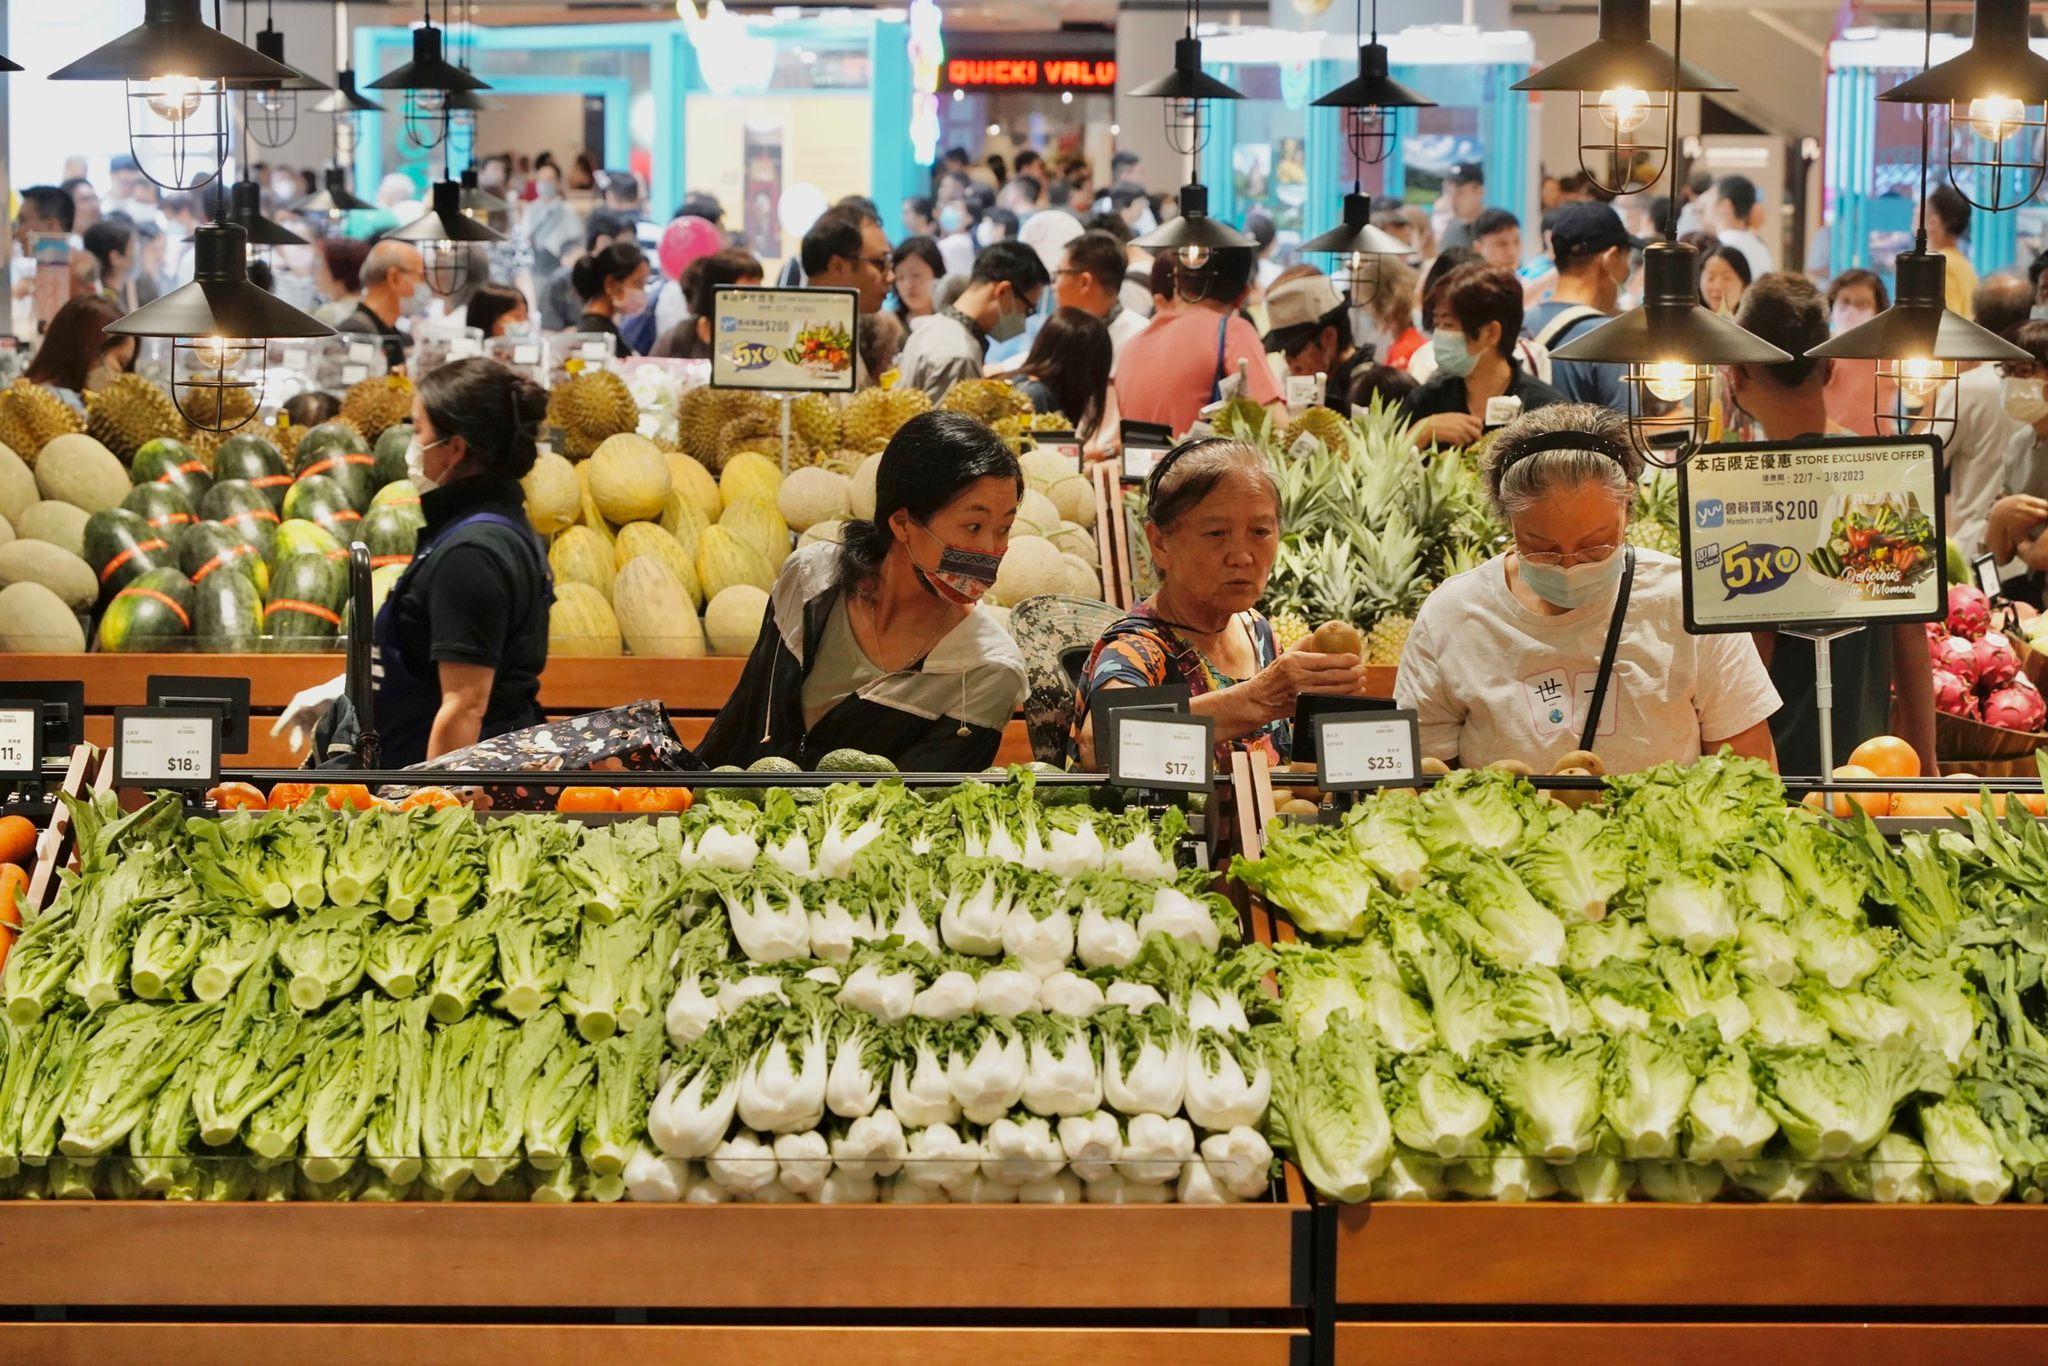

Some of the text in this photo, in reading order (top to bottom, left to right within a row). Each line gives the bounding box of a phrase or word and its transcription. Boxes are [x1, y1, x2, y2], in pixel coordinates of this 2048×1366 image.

[1694, 450, 1925, 472] 本店限定優惠 STORE EXCLUSIVE OFFER
[1793, 473, 1813, 483] 22/7
[1824, 470, 1865, 482] 3/8/2023
[1698, 504, 1722, 526] yuu
[1775, 499, 1818, 522] $200
[1841, 566, 1901, 583] Delicious
[1534, 678, 1562, 702] 世
[168, 757, 200, 771] $18.0
[1165, 761, 1196, 776] $17.0
[1368, 756, 1402, 771] $23.0
